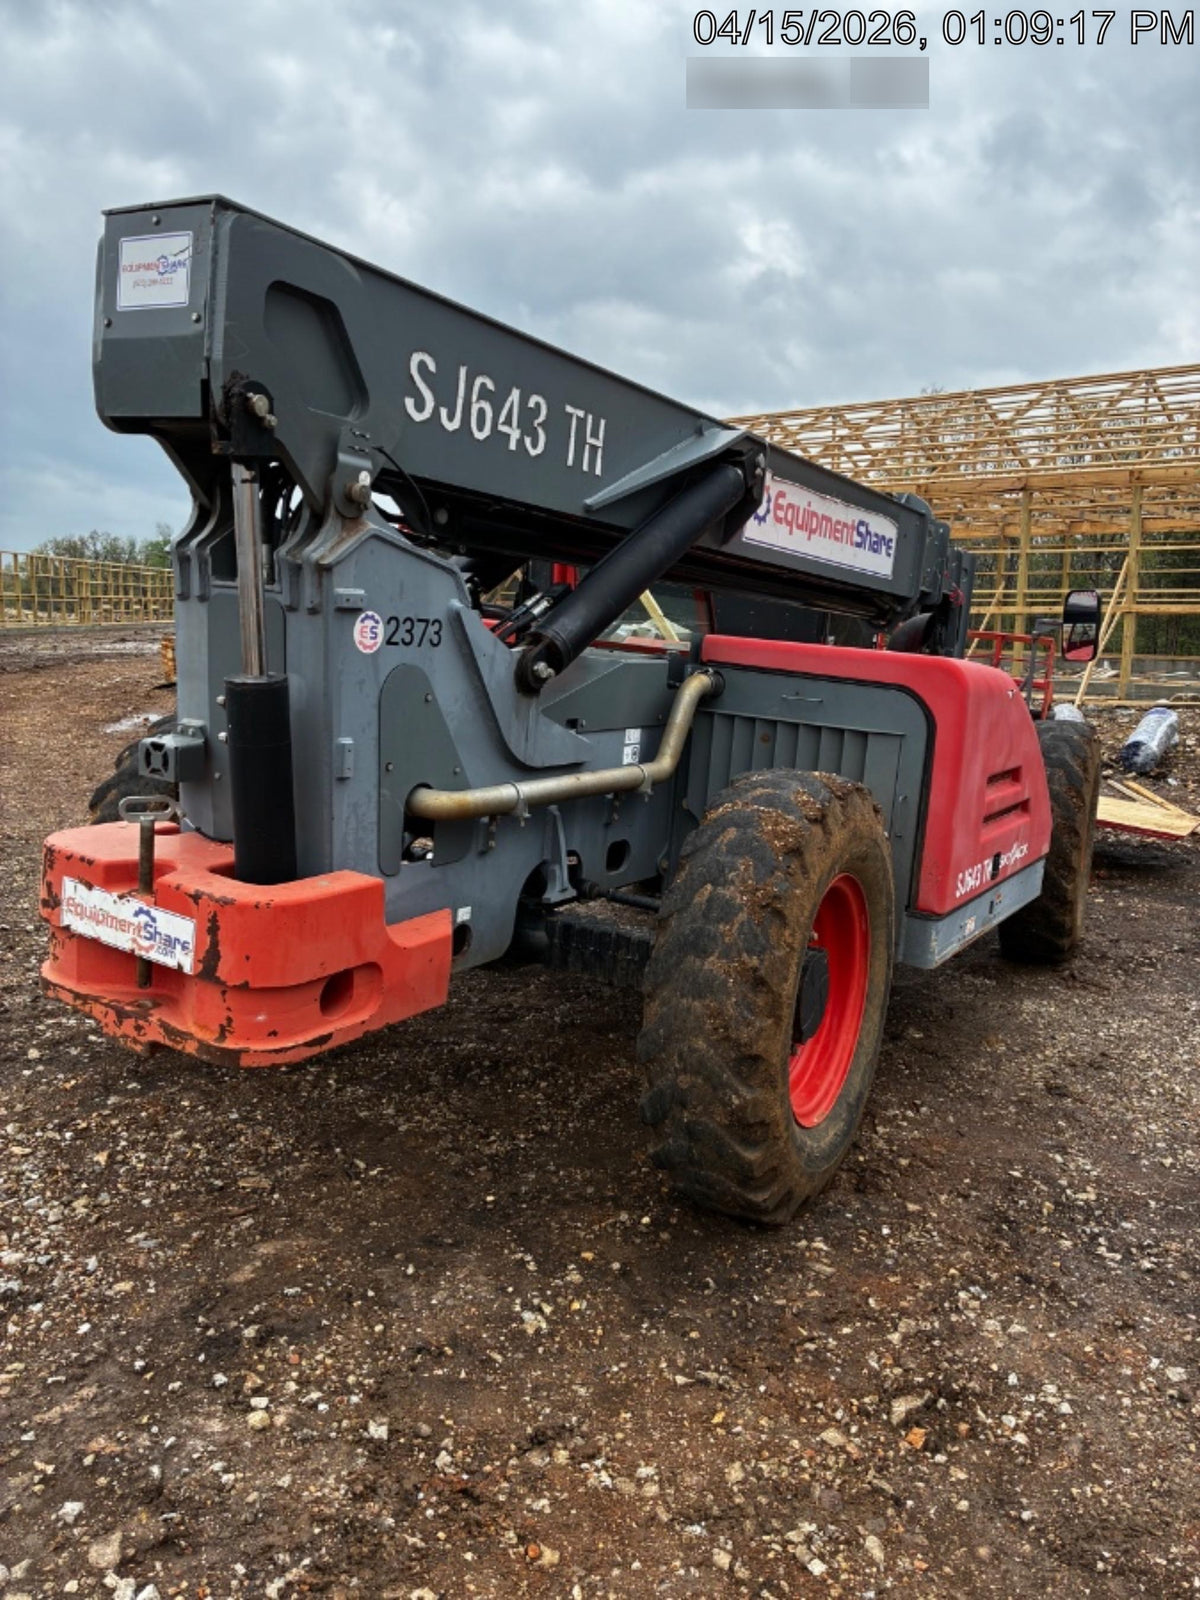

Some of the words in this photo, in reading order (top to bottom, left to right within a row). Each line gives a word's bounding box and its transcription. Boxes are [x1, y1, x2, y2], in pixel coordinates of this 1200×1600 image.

[404, 351, 548, 457] SJ643
[564, 404, 607, 477] TH
[772, 490, 894, 557] EquipmentShare
[385, 616, 443, 647] 2373
